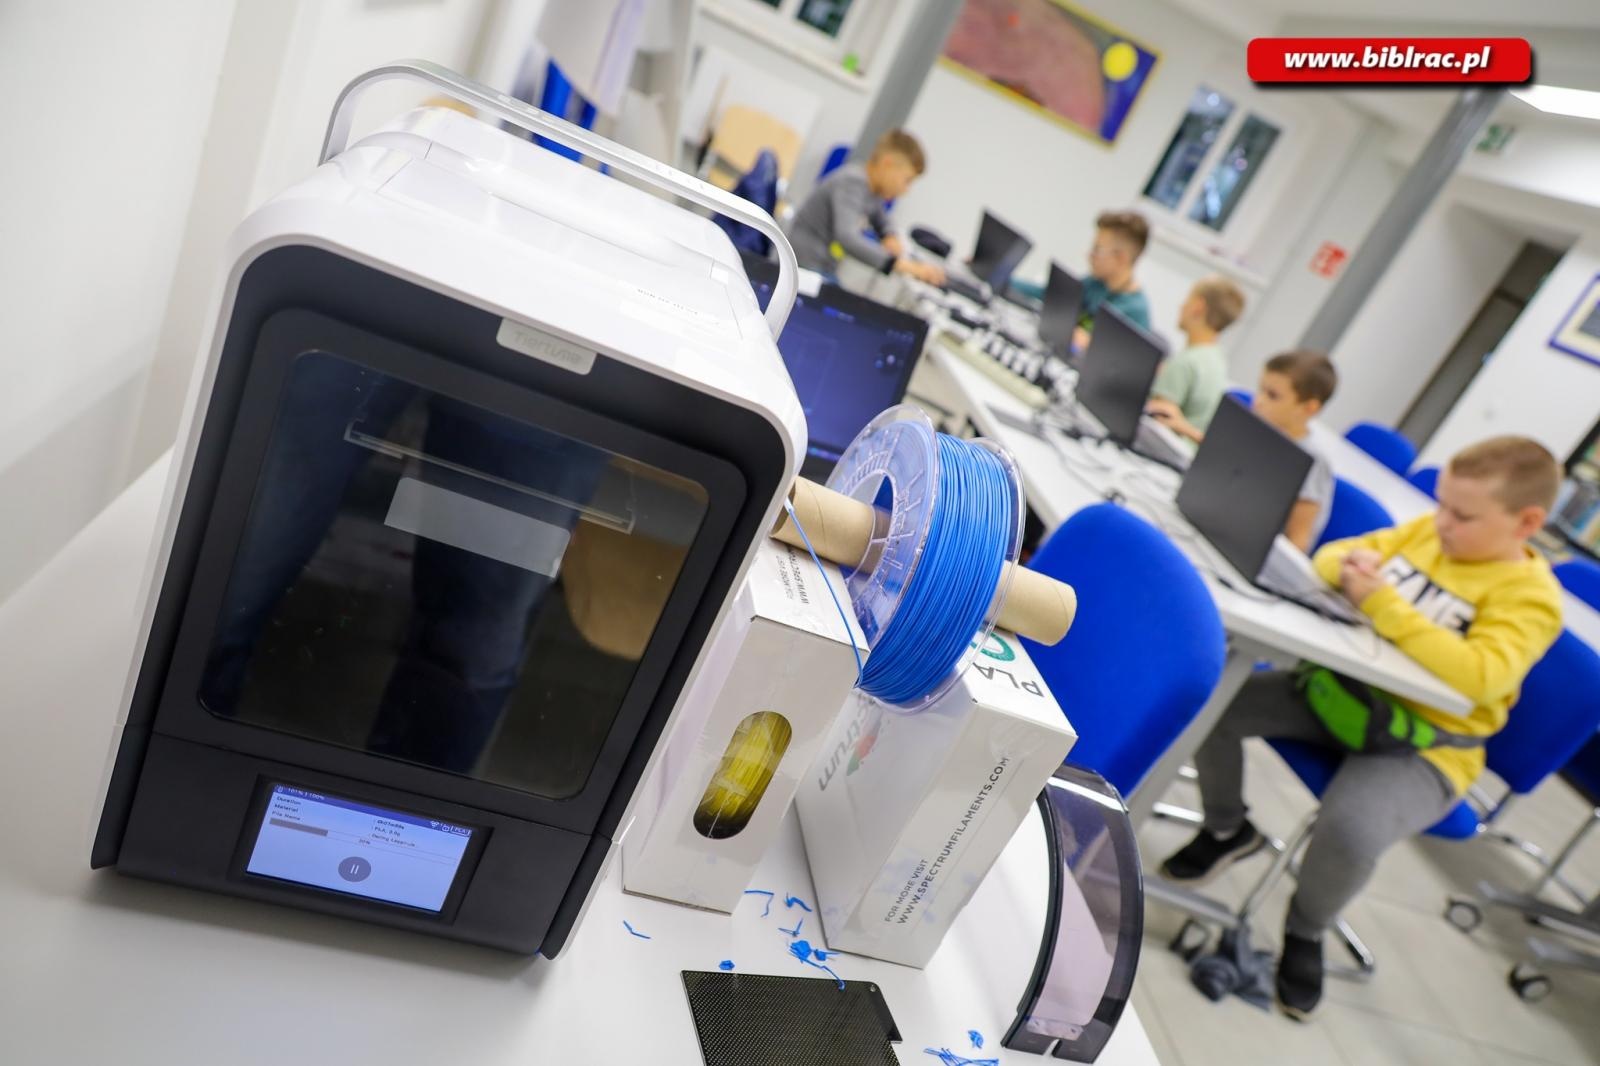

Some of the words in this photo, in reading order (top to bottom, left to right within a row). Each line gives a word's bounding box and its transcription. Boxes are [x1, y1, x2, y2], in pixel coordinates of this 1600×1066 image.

[972, 662, 1044, 698] PLA
[818, 693, 877, 792] ctrum
[896, 756, 1010, 924] WWW.SPECTRUMFILAMENTS.COM
[884, 905, 901, 922] FOR
[895, 879, 915, 905] MORE
[911, 859, 928, 879] VISIT
